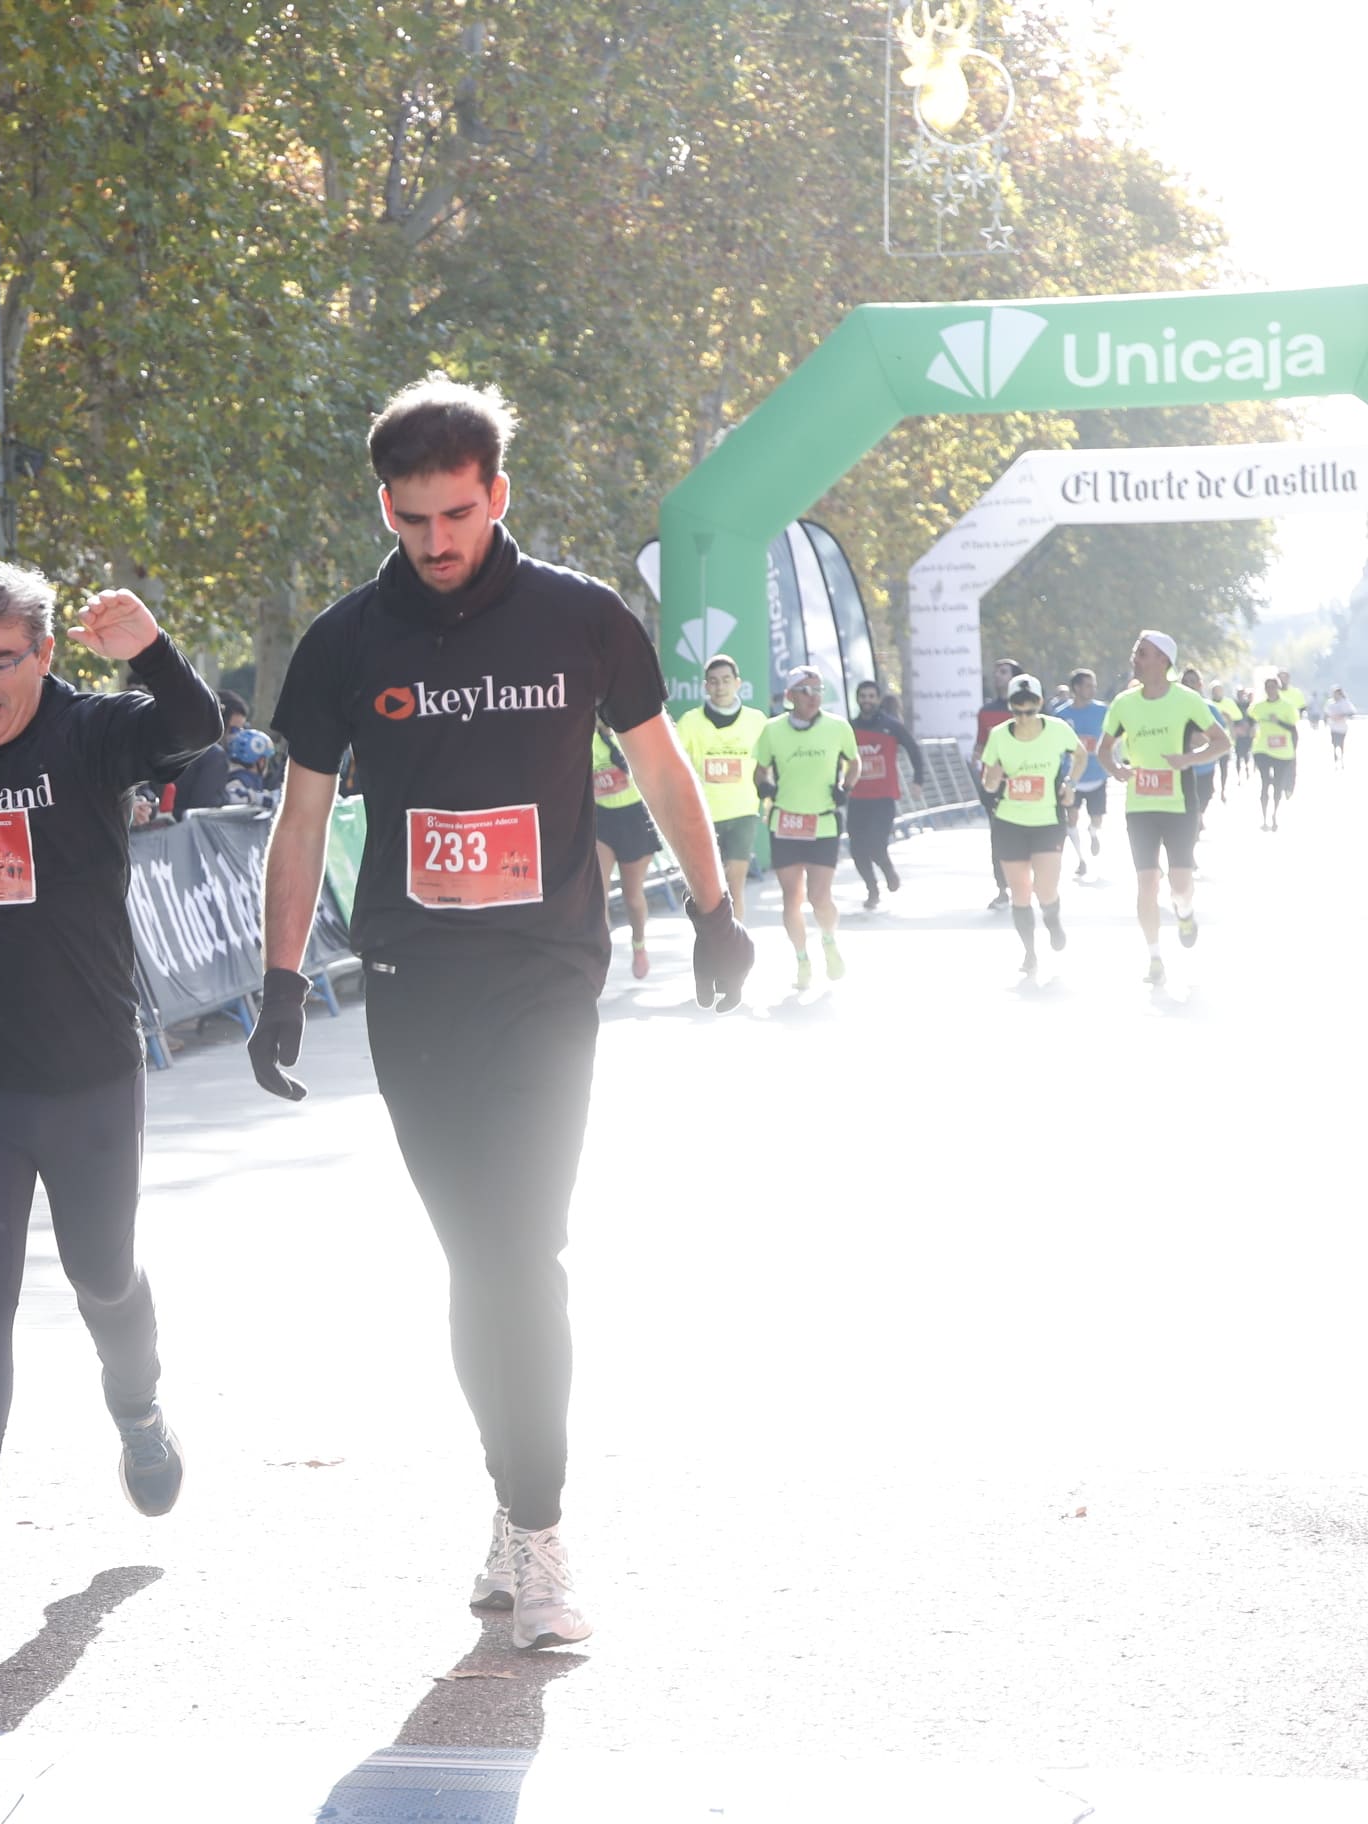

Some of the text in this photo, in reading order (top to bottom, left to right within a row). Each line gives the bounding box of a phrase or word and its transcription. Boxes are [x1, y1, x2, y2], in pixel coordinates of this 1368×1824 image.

[1063, 321, 1325, 391] Unicaja
[1060, 461, 1359, 505] El Norte de Castilla
[413, 673, 569, 722] keyland
[1138, 773, 1159, 788] 570
[425, 830, 488, 873] 233
